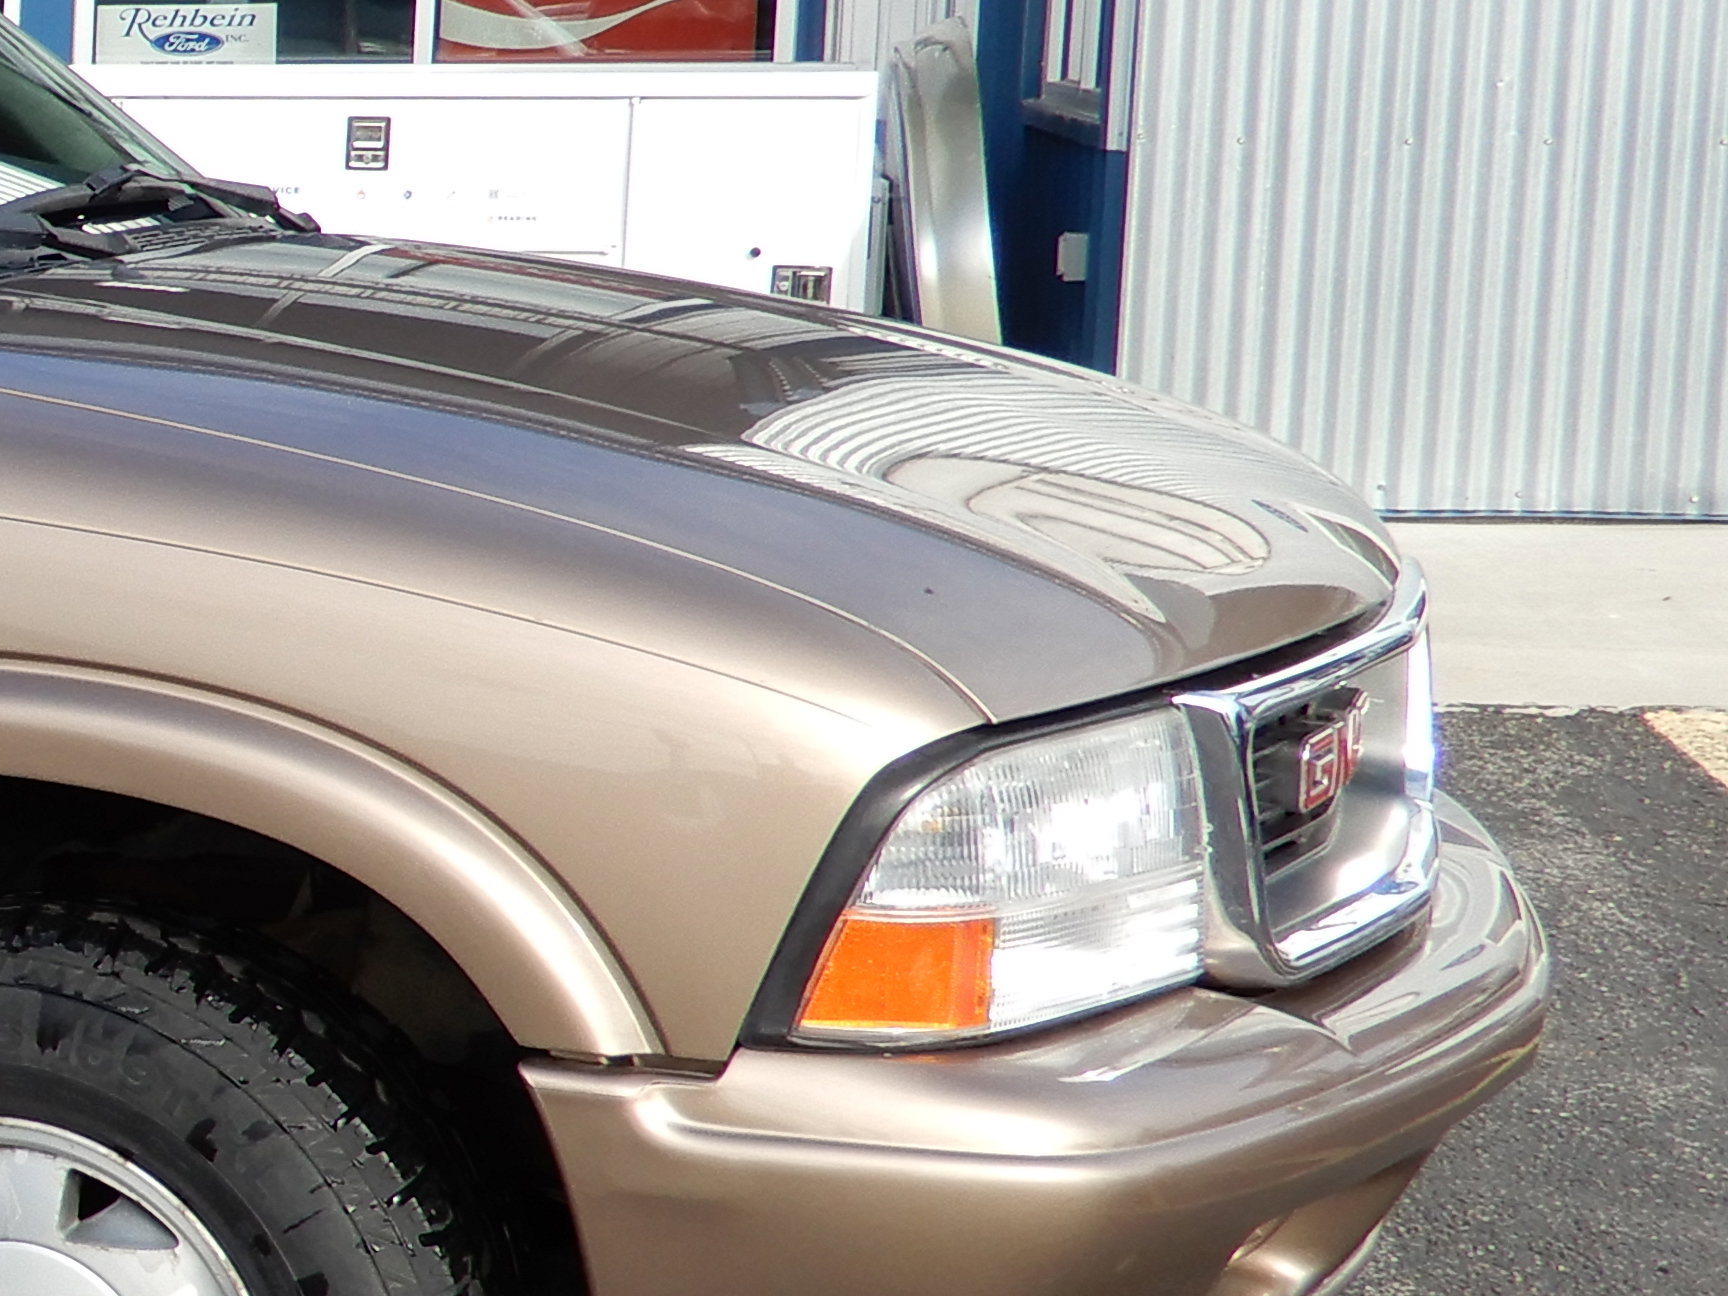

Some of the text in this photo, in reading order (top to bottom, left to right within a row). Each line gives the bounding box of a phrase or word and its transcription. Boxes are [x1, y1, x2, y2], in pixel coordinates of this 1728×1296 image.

[118, 7, 257, 40] Rehbein
[163, 33, 250, 52] Ford INC.
